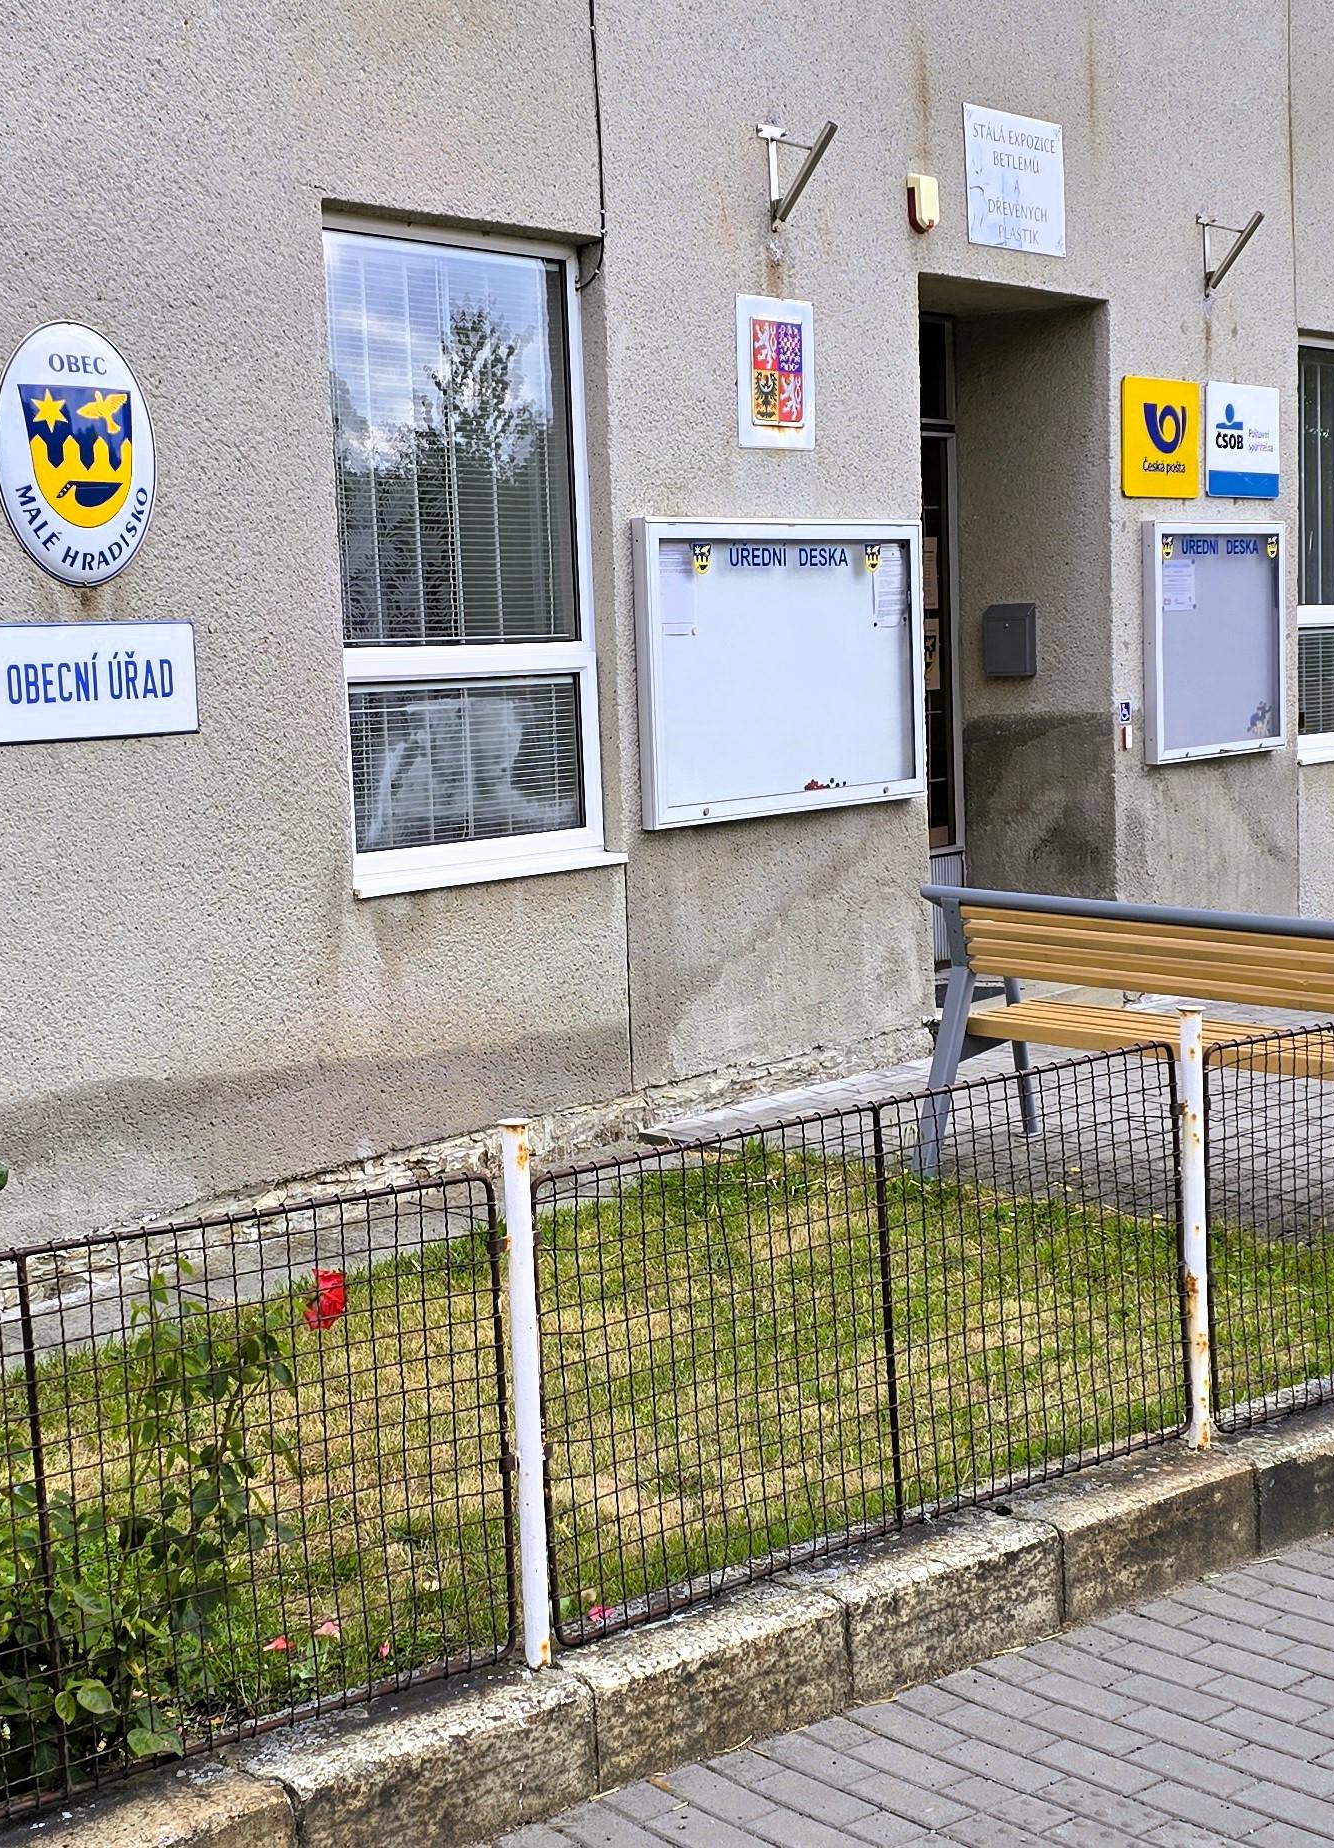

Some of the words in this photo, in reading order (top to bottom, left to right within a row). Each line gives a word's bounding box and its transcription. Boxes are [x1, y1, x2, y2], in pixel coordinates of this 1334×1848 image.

[973, 121, 1006, 144] STÁLÁ
[1008, 130, 1056, 153] EXPOZICE
[1013, 179, 1021, 195] A
[998, 224, 1040, 245] PLASTIK
[48, 353, 107, 375] OBEC
[1216, 430, 1244, 450] ČSOB
[1142, 456, 1165, 473] Česká
[1166, 460, 1186, 476] pošta
[15, 484, 63, 552] MALÉ
[61, 487, 148, 571] HRADISKO
[729, 542, 787, 567] ÚŘEDNÍ
[799, 547, 849, 567] DESKA
[1181, 535, 1219, 555] ÚŘEDNÍ
[1226, 539, 1259, 555] DESKA
[7, 652, 99, 704] OBECNÍ
[108, 650, 174, 700] ÚŘAD
